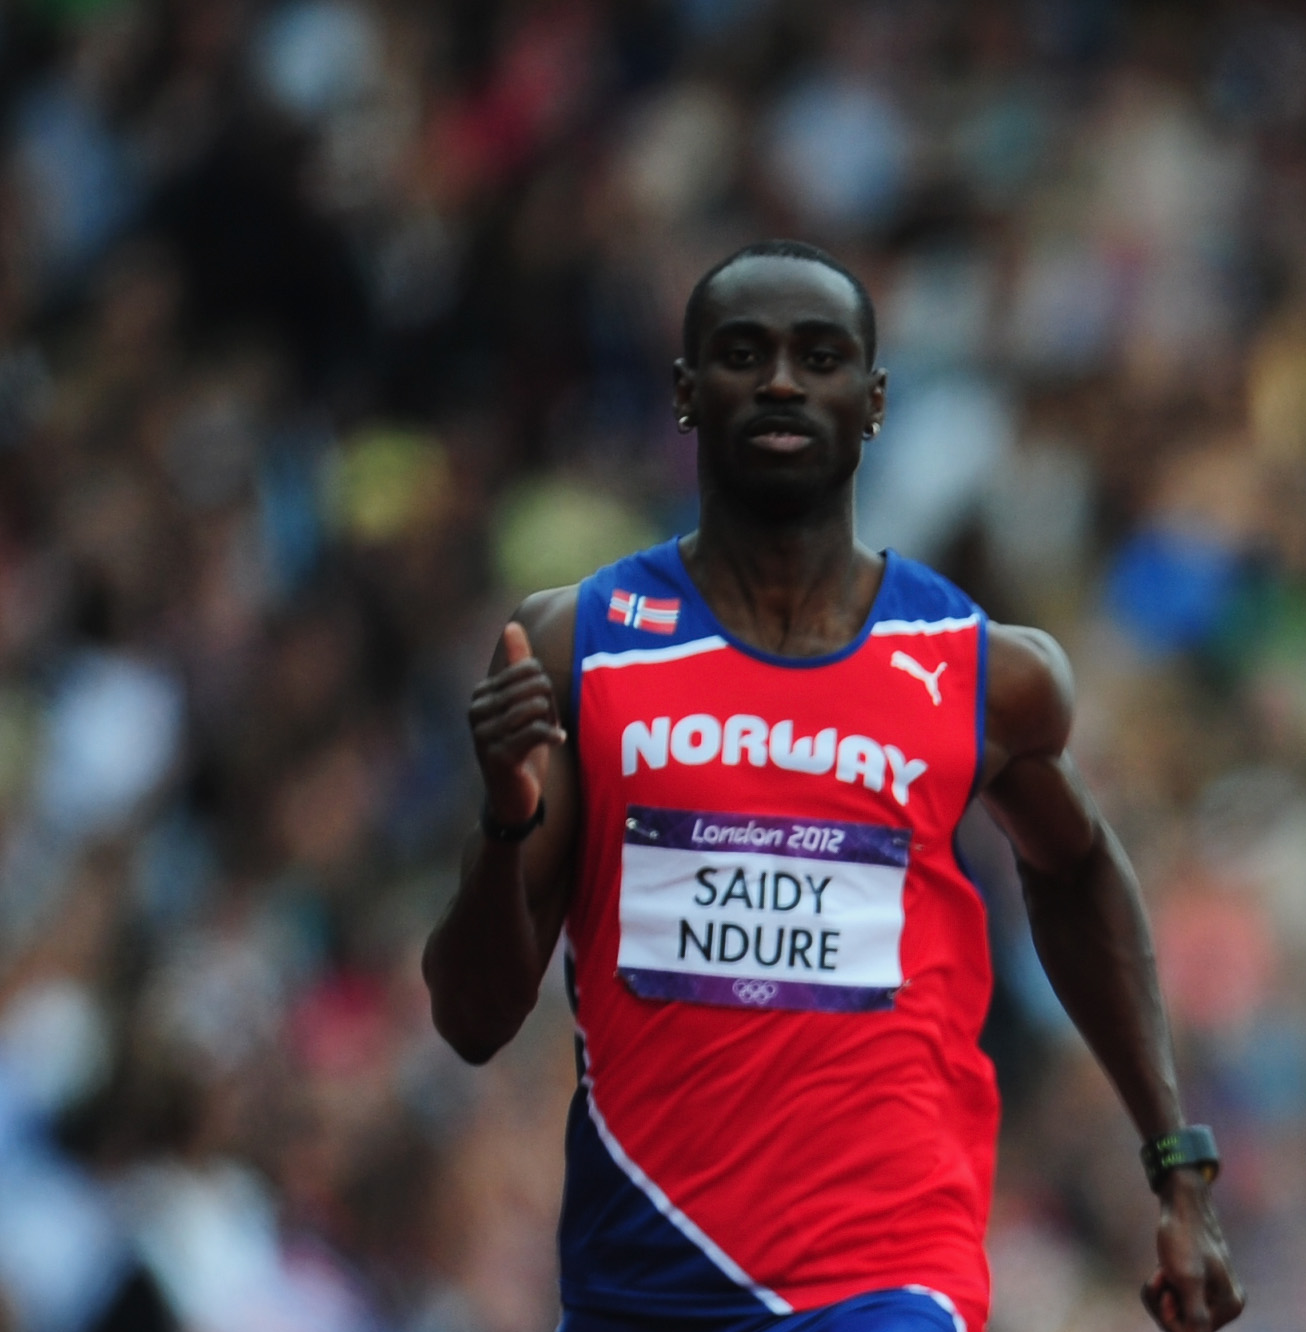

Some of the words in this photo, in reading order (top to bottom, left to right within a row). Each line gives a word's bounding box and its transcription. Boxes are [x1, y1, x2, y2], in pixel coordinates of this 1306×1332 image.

[622, 713, 928, 805] NORWAY
[691, 819, 783, 848] London
[786, 825, 846, 854] 2012
[693, 866, 832, 916] SAIDY
[678, 918, 841, 971] NDURE
